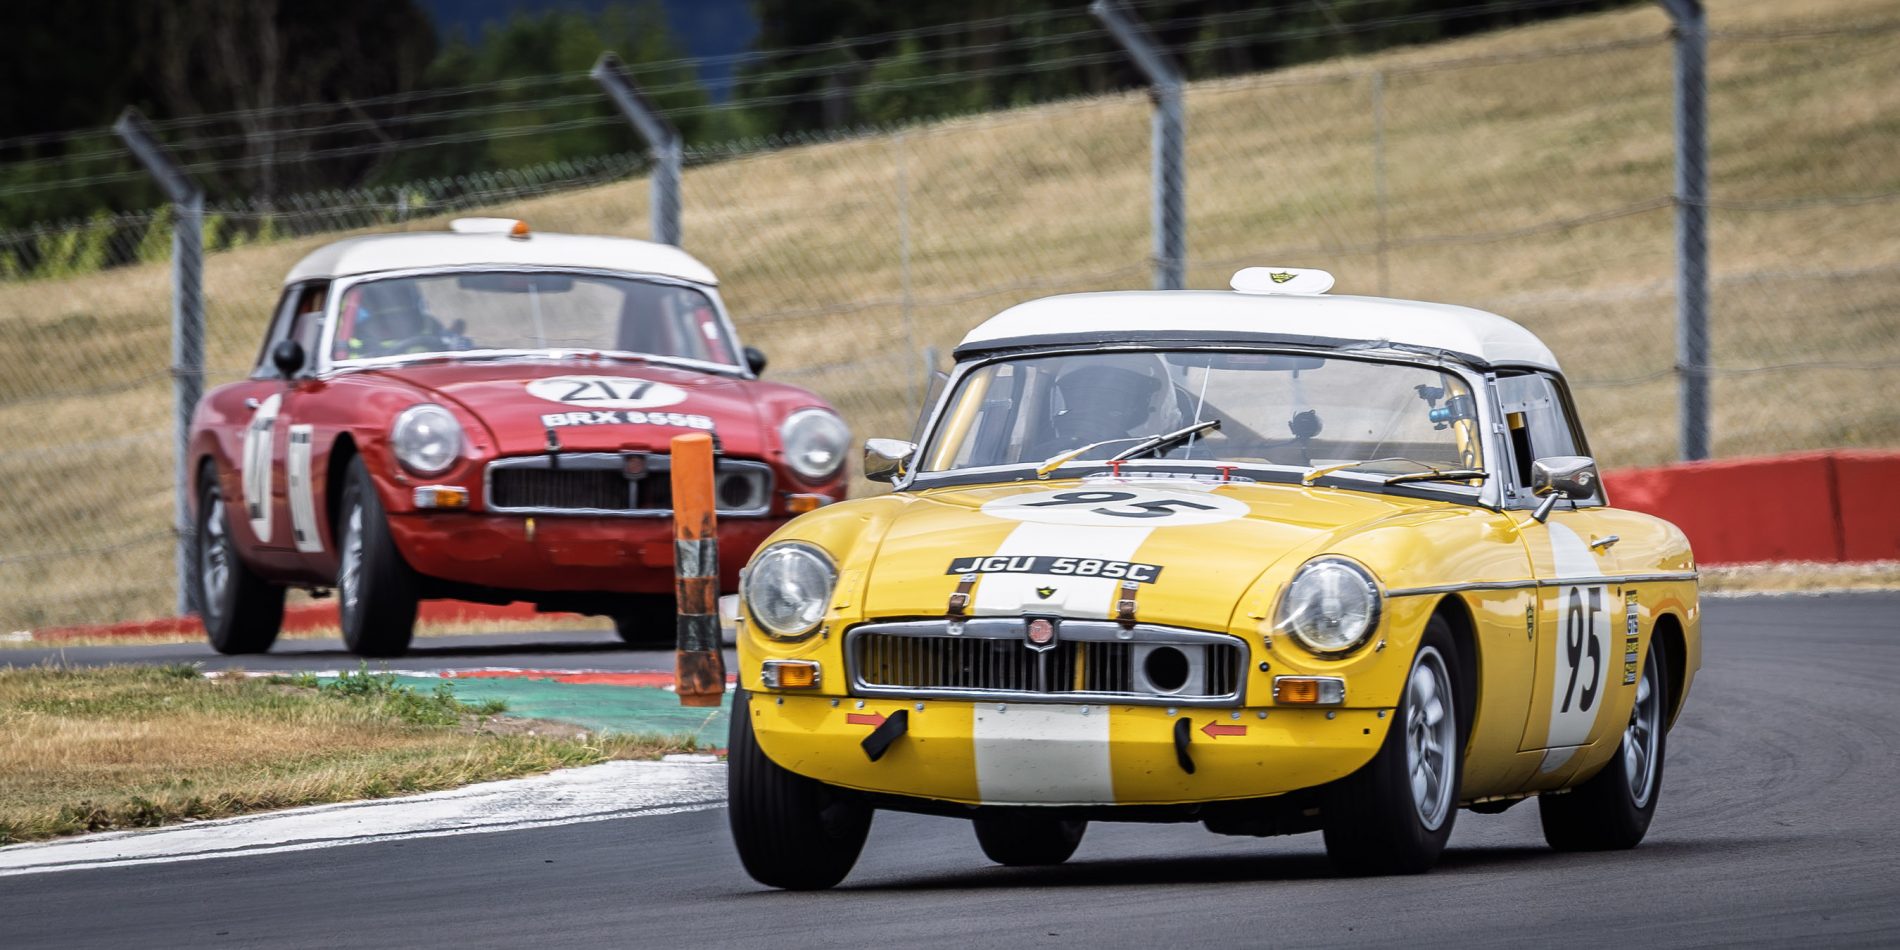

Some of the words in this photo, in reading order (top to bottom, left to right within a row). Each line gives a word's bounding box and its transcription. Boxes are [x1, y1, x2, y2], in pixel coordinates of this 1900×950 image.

[542, 379, 654, 401] 217
[541, 411, 621, 427] BRX
[1020, 491, 1218, 518] 95
[954, 556, 1035, 573] JGU
[1049, 557, 1153, 581] 585C
[1560, 586, 1602, 713] 95
